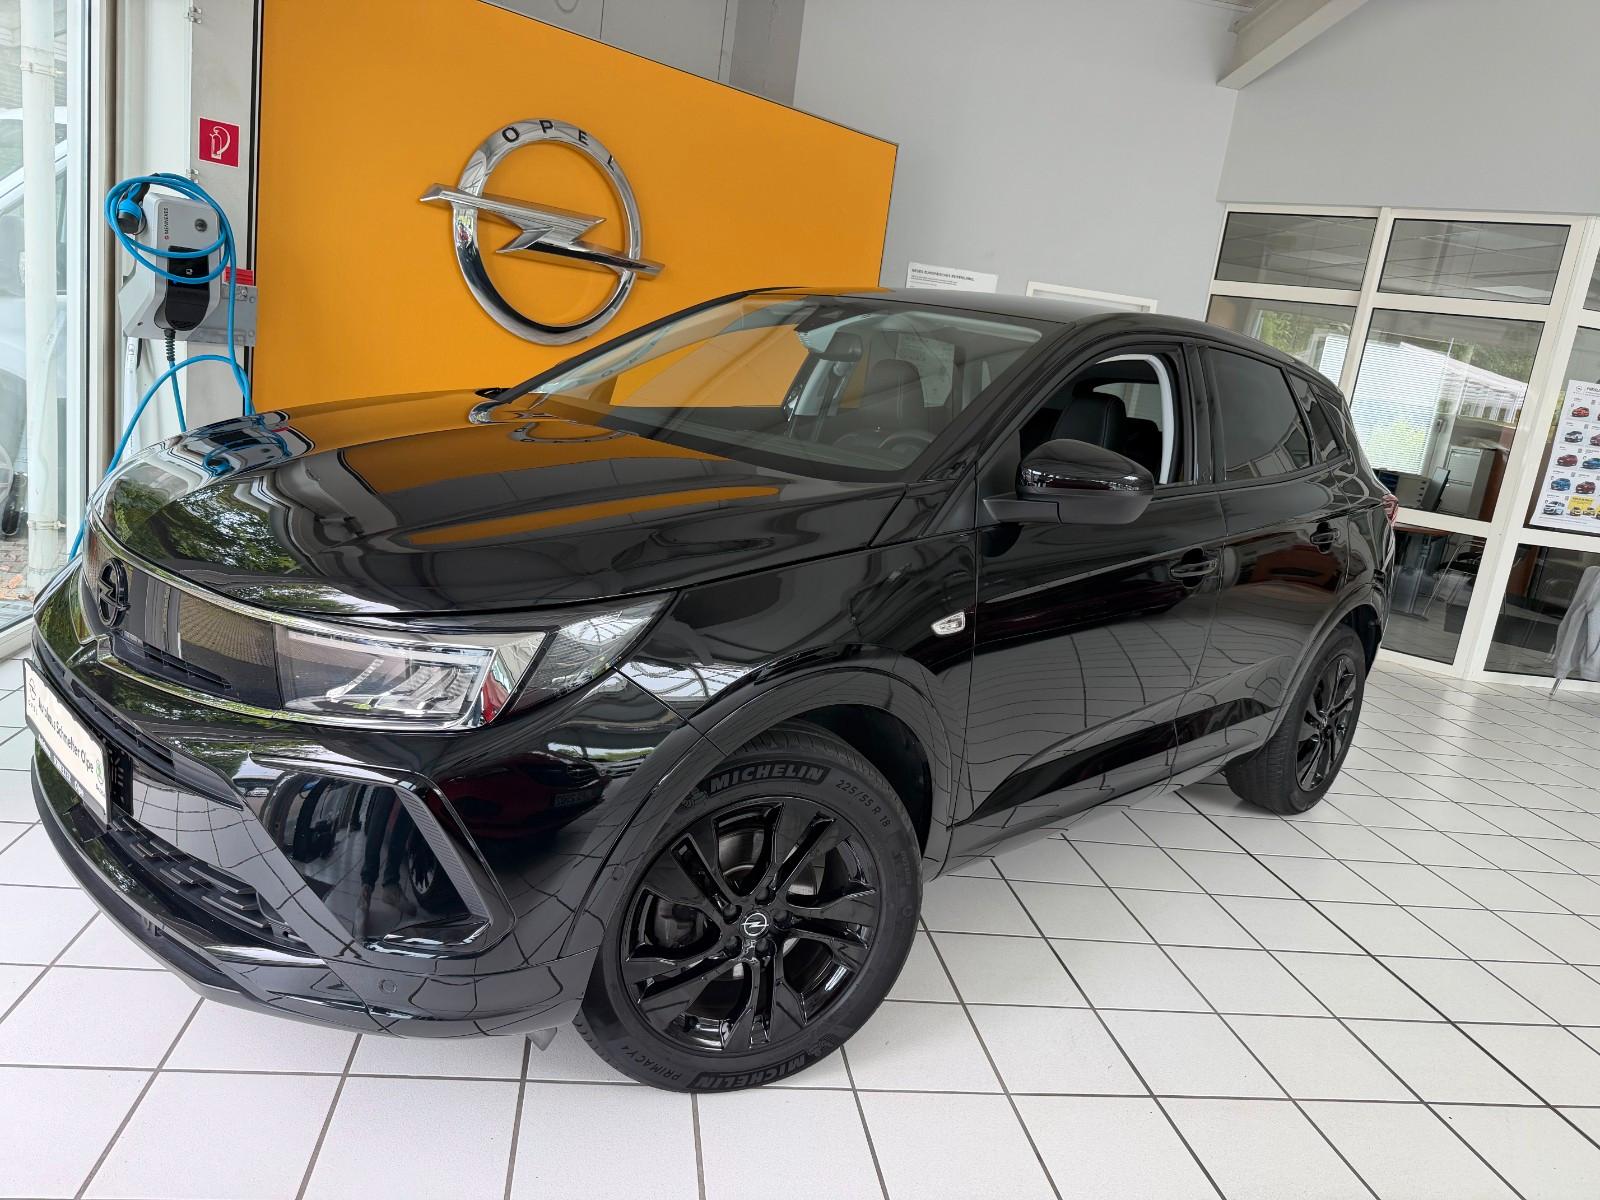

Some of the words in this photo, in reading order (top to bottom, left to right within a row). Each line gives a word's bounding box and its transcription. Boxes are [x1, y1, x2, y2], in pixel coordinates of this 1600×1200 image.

[502, 119, 615, 172] OPEL
[710, 764, 826, 793] MICHELIN
[835, 779, 873, 808] 225/55
[872, 806, 882, 817] R
[880, 815, 892, 828] 18
[626, 1050, 682, 1081] PRIMACY
[697, 1054, 806, 1088] MICHELIN
